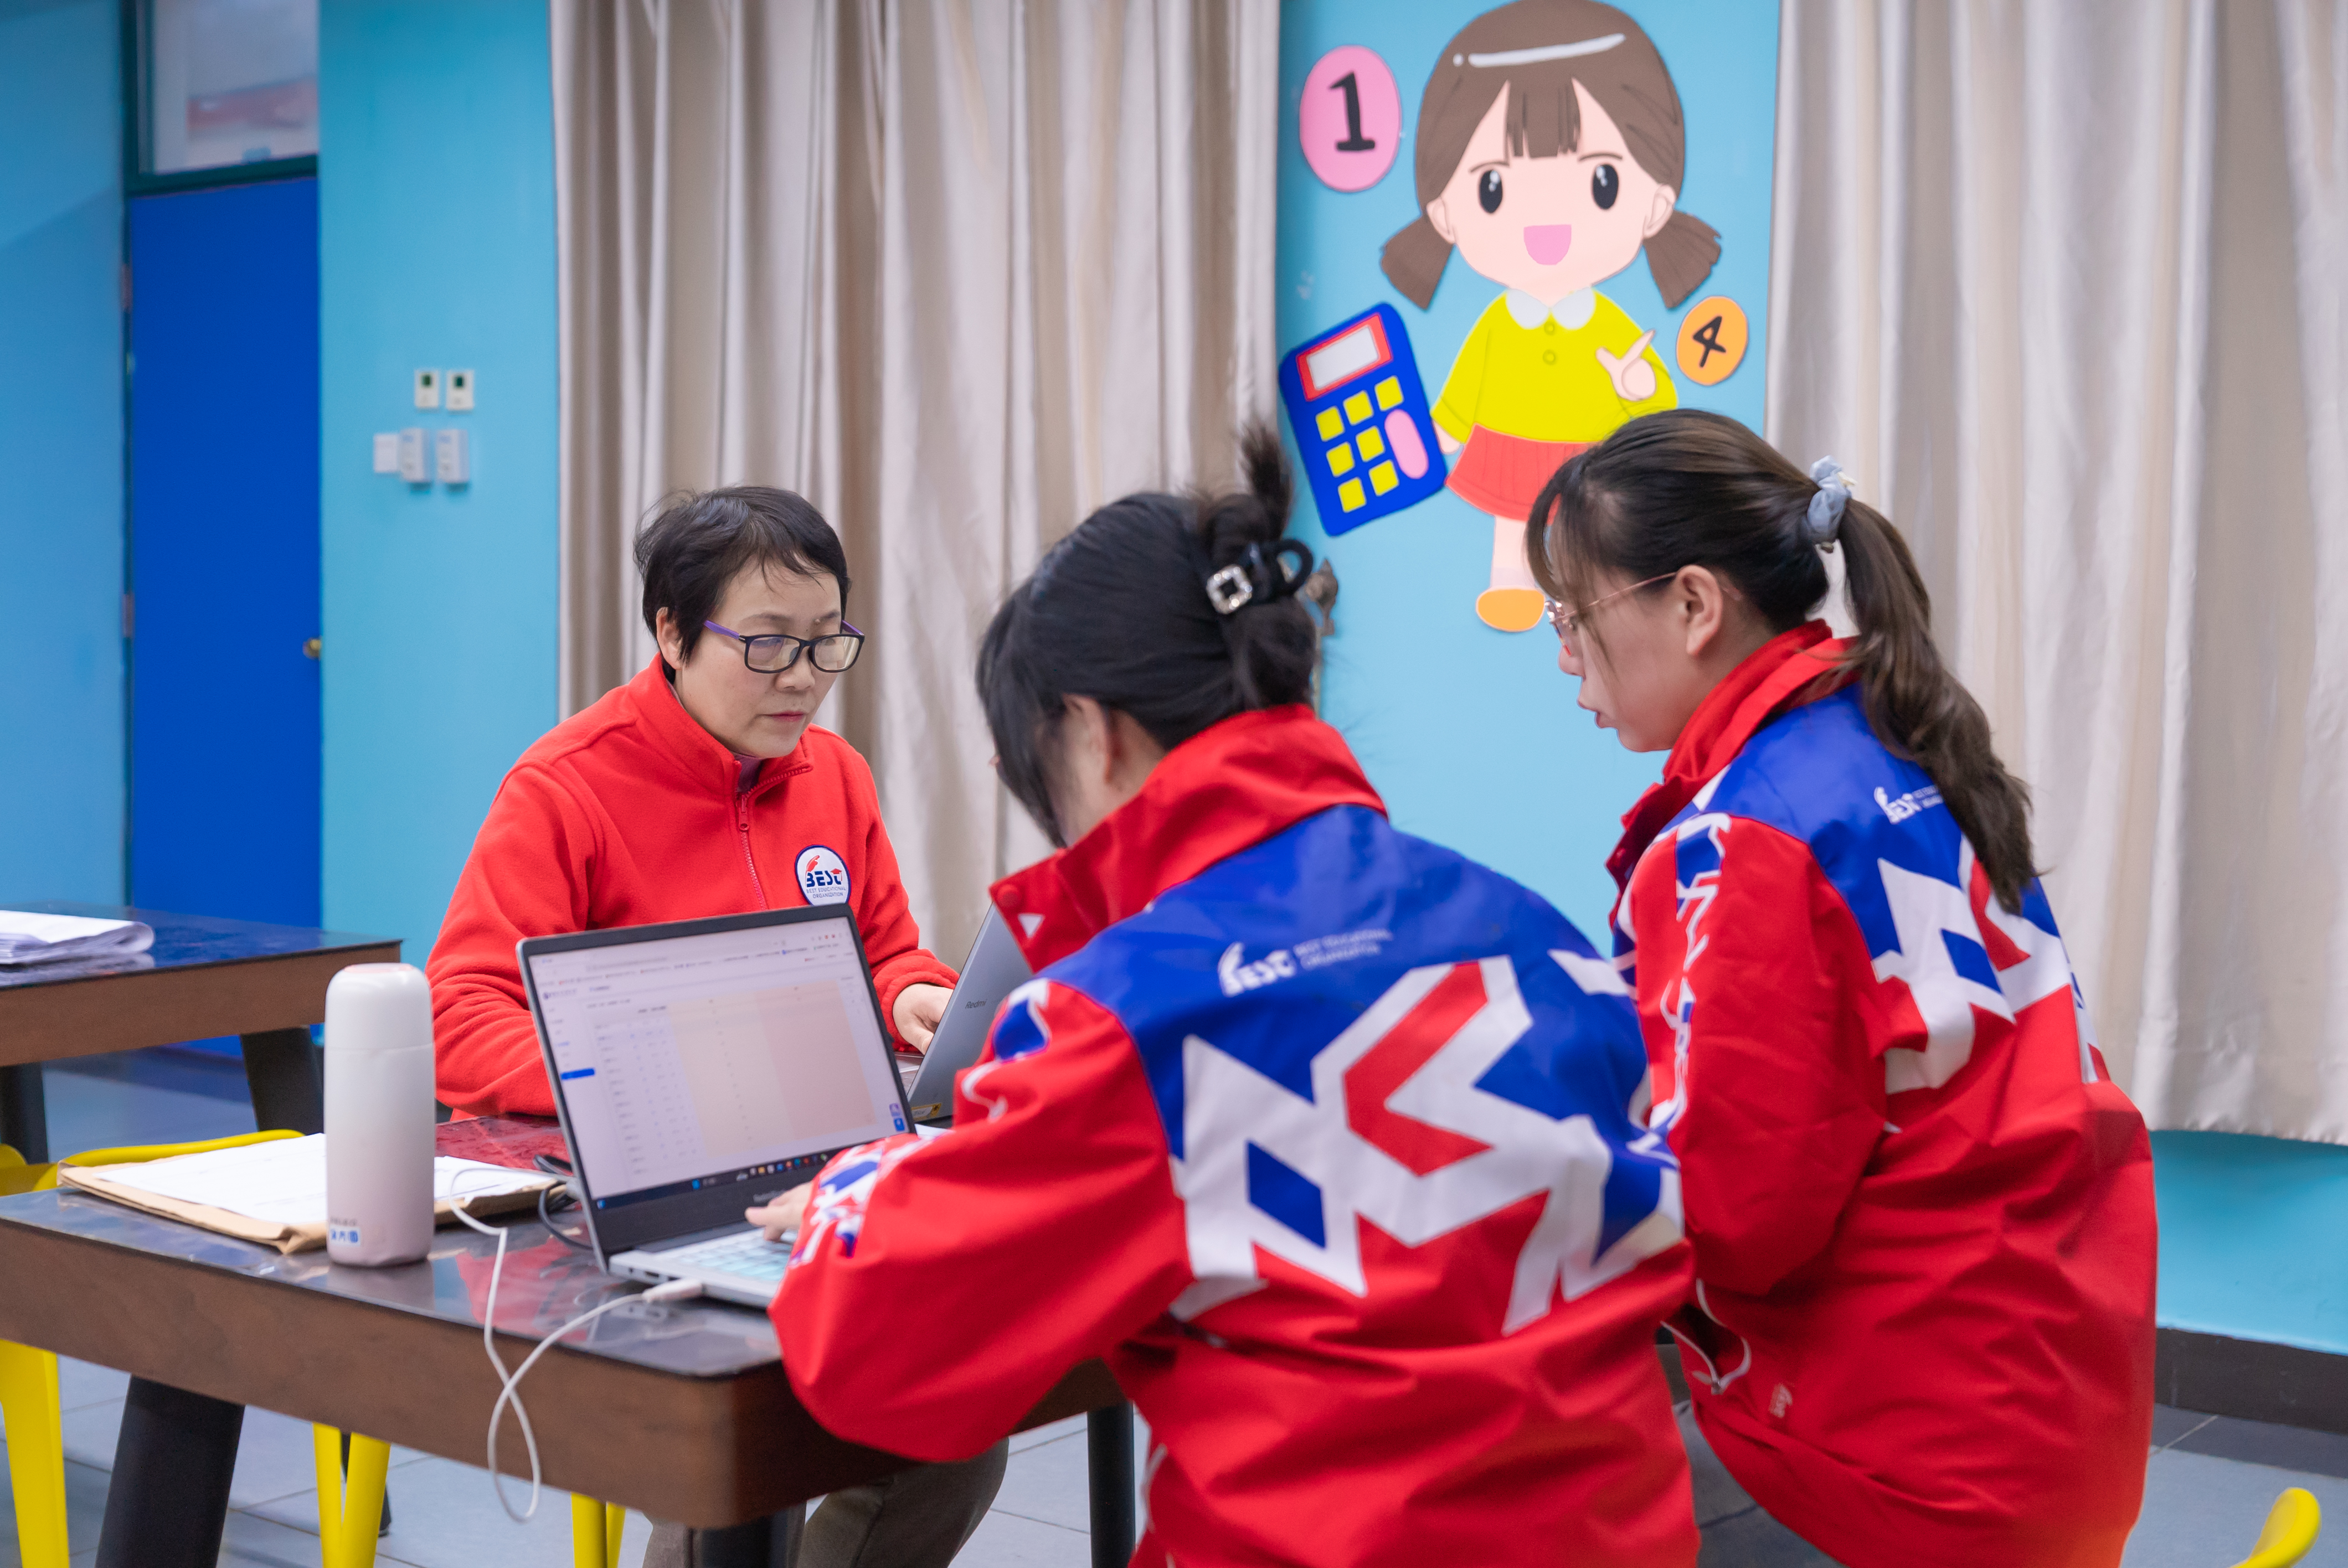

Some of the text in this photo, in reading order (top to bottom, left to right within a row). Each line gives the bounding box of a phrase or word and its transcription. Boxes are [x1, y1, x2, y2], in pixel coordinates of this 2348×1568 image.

[1328, 71, 1376, 152] 1
[1692, 315, 1728, 368] 4
[806, 869, 842, 888] BEST
[965, 998, 988, 1009] Redmi
